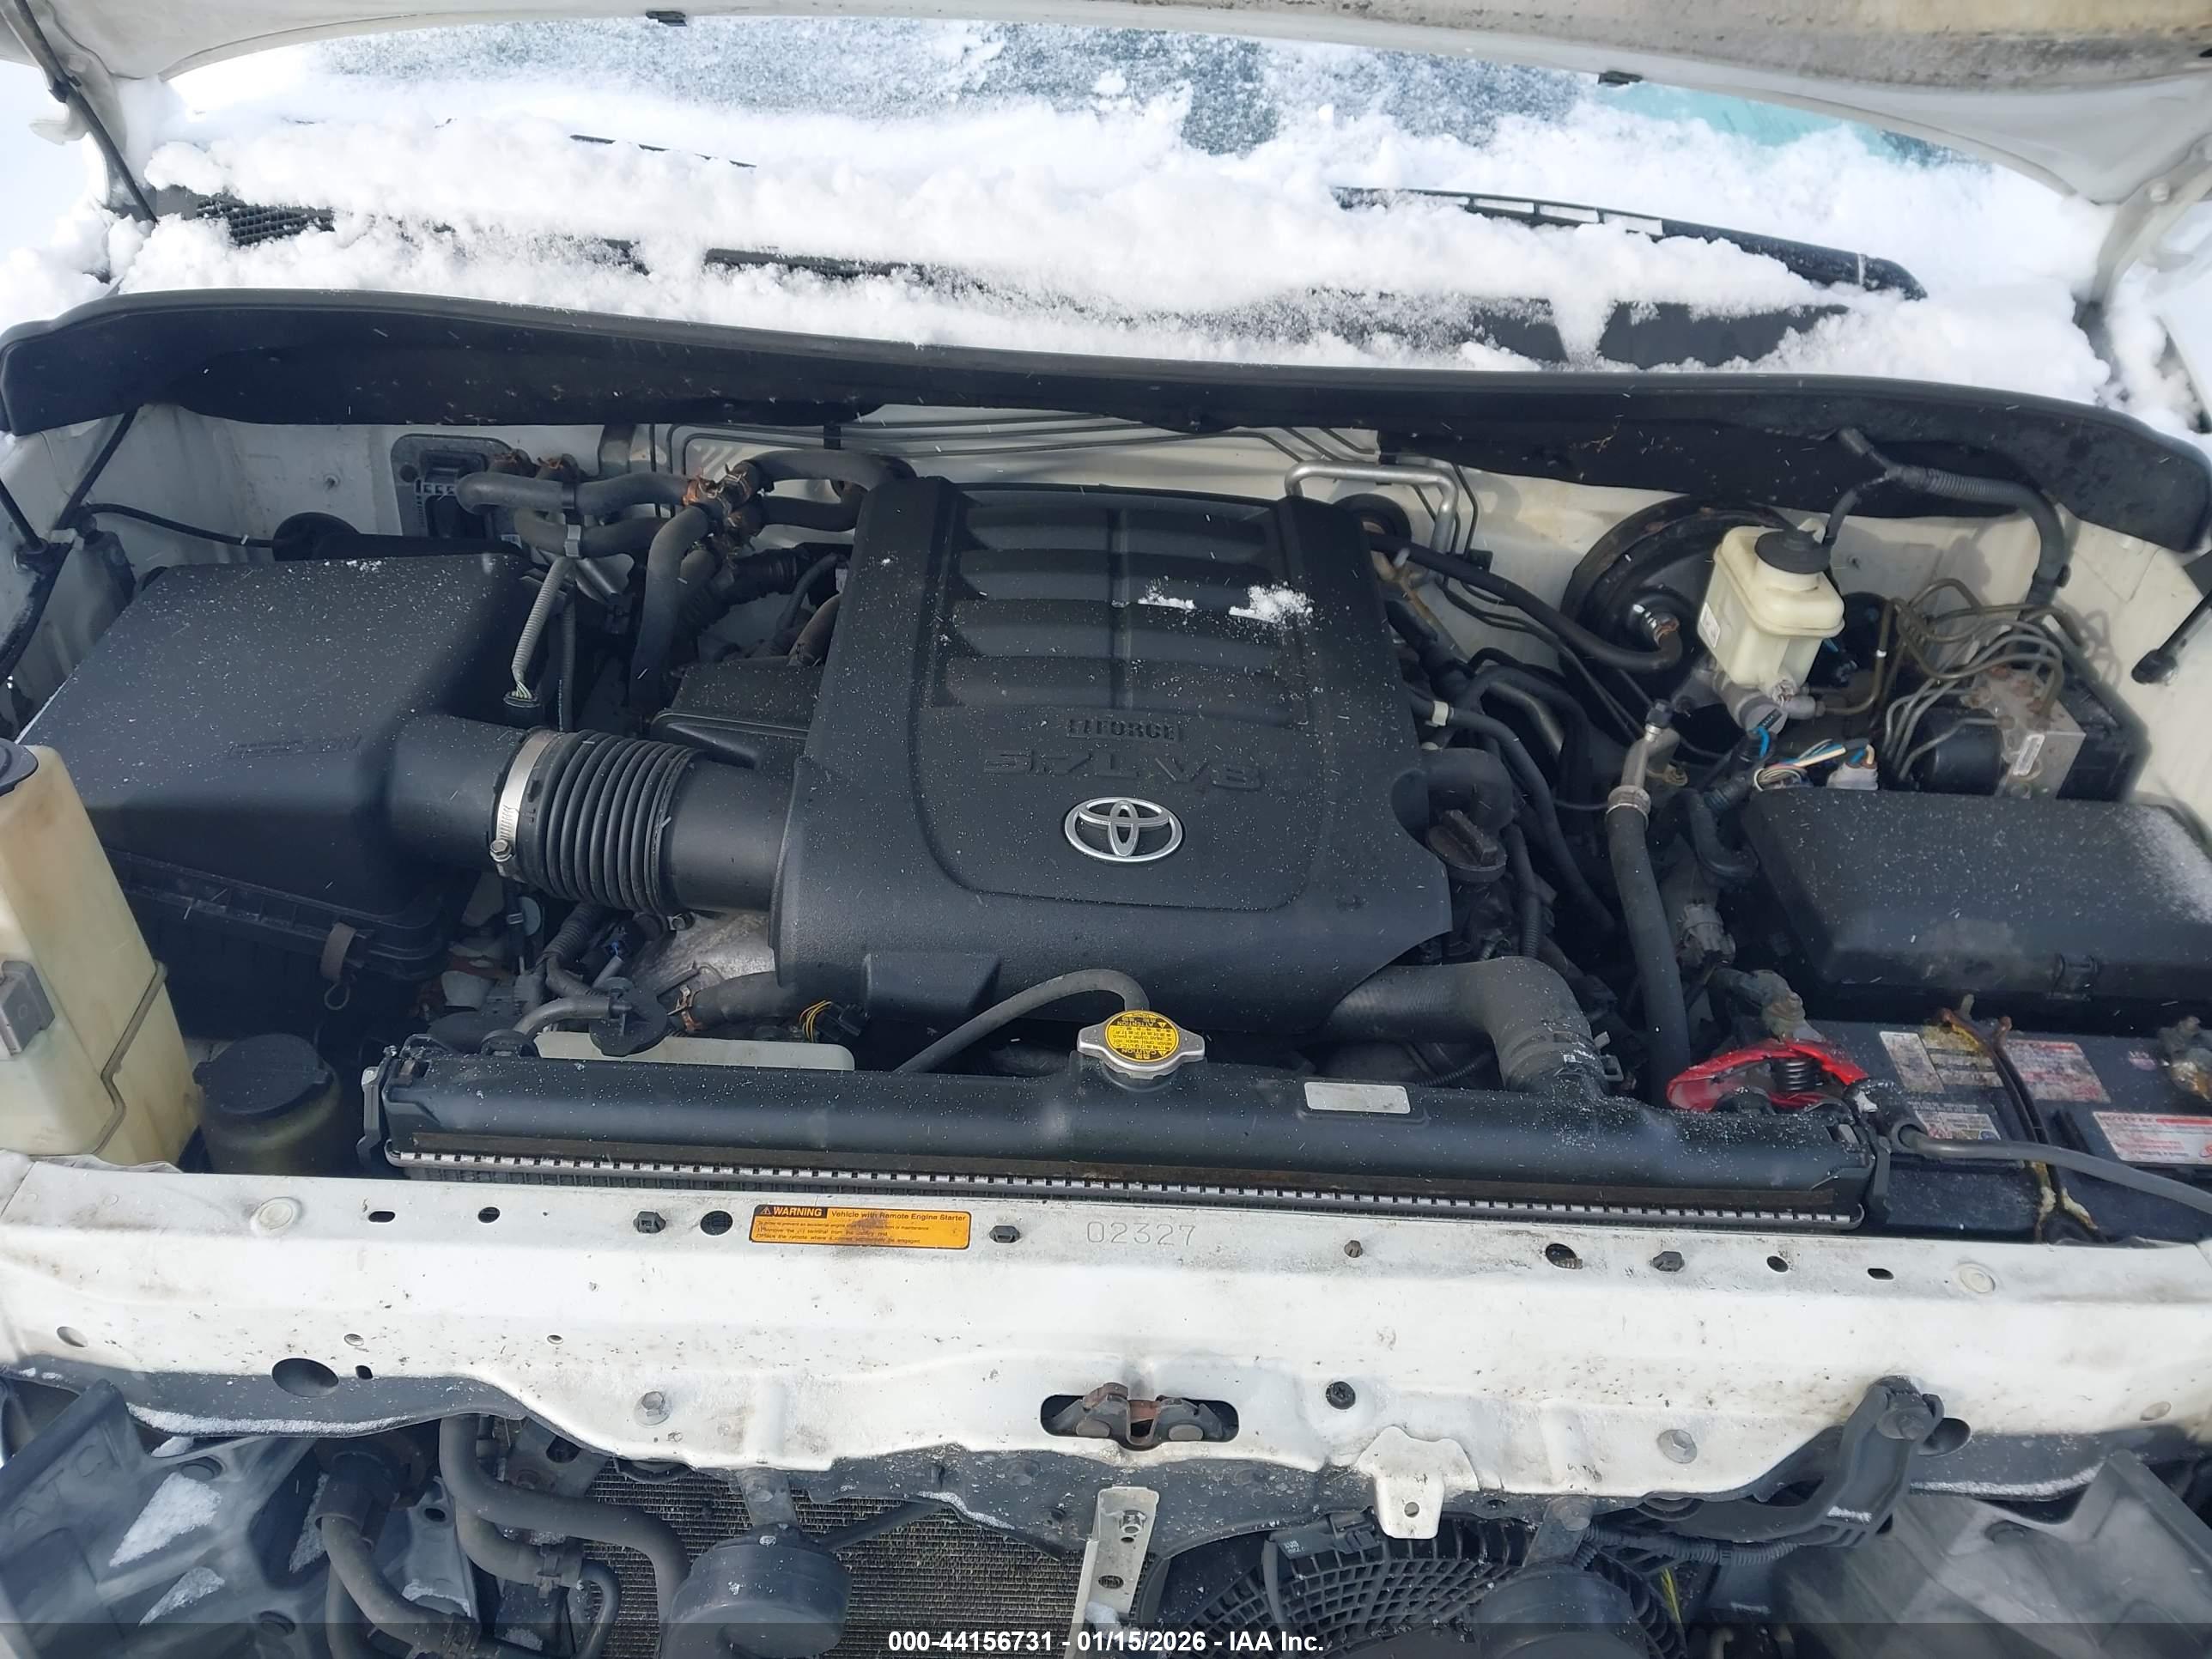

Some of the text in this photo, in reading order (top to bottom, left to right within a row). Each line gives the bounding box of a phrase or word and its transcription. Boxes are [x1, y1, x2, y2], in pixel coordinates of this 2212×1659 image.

[772, 1206, 823, 1217] WARNING
[879, 1212, 909, 1220] Remote
[910, 1213, 938, 1222] Engine
[1086, 1221, 1196, 1246] 02327
